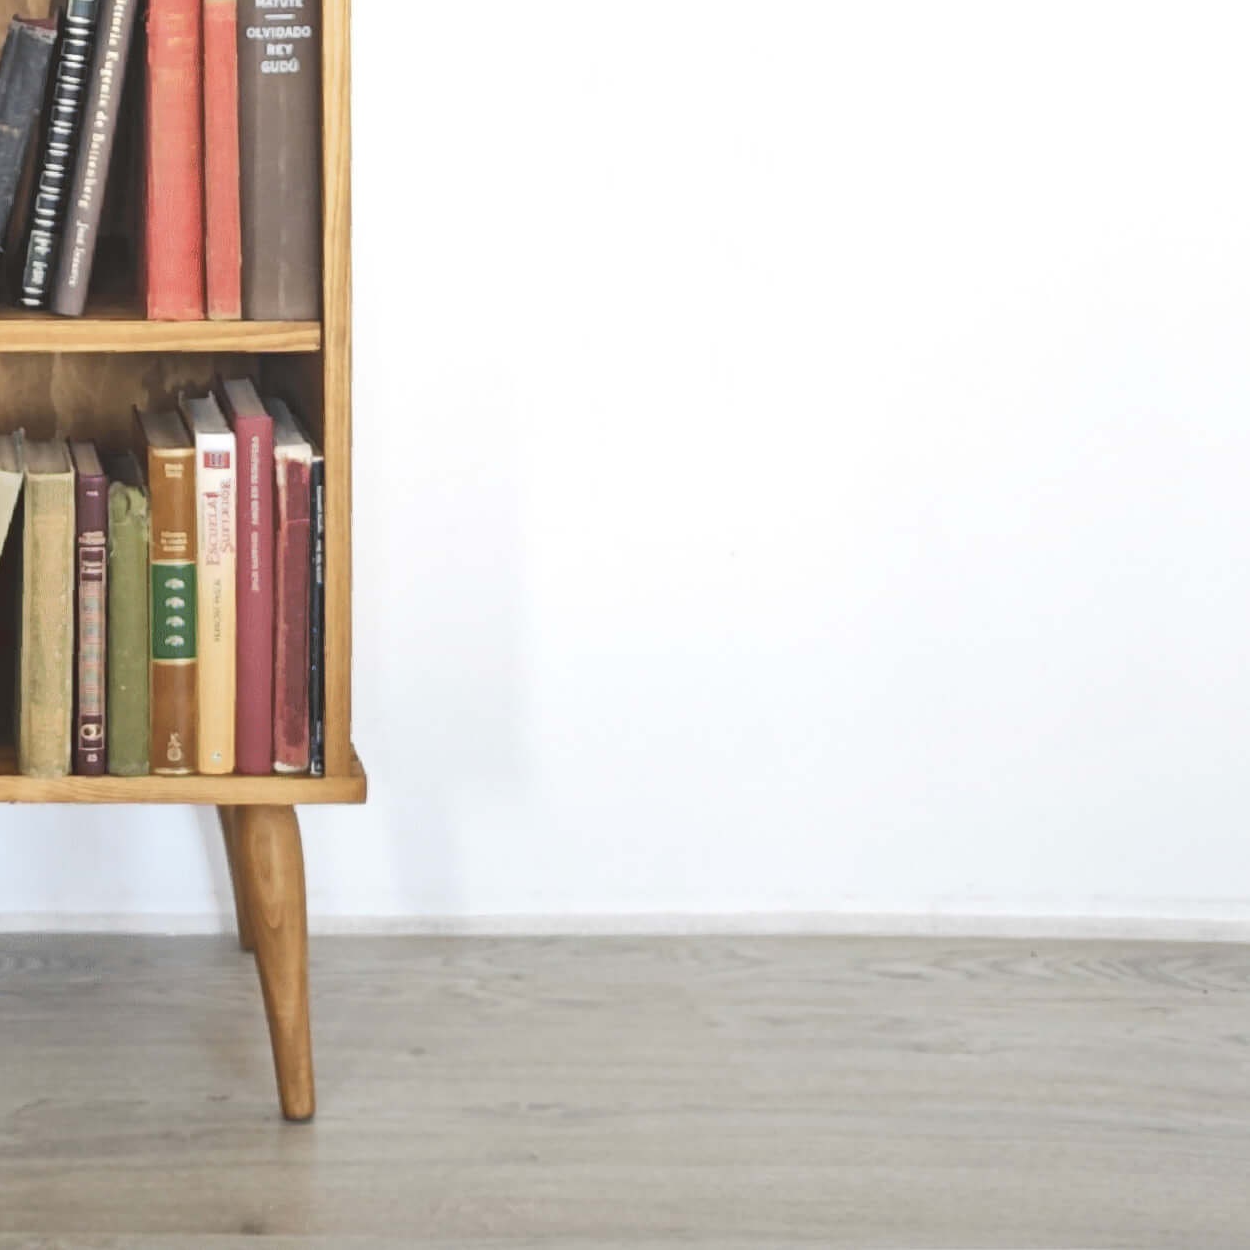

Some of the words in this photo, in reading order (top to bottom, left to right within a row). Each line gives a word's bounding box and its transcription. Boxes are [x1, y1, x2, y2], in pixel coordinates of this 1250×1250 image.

[246, 26, 312, 39] OLVIDADO
[266, 44, 294, 56] REY
[260, 57, 301, 74] GUDÚ
[99, 51, 120, 107] Eugenia
[94, 111, 108, 128] de
[78, 133, 106, 210] Battenberg
